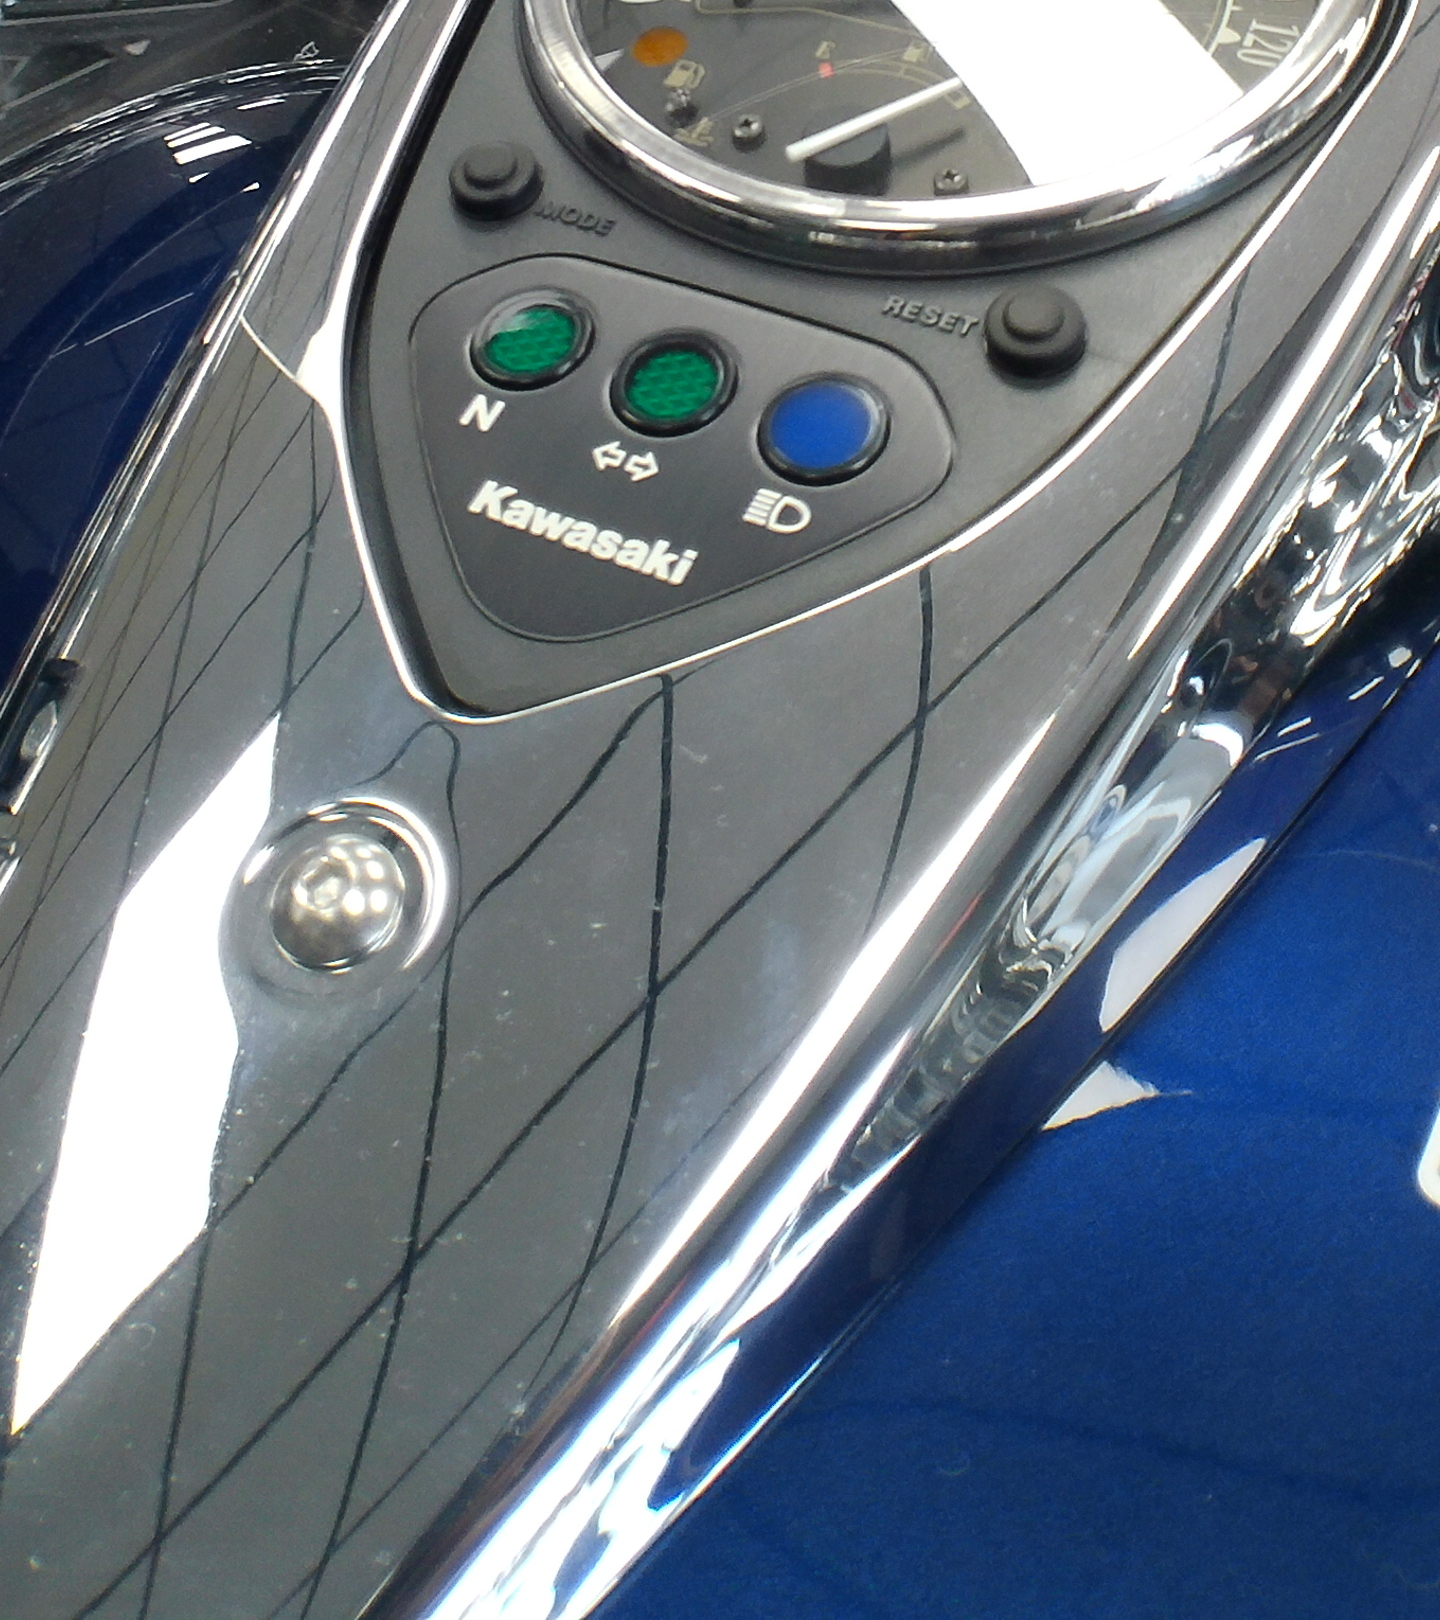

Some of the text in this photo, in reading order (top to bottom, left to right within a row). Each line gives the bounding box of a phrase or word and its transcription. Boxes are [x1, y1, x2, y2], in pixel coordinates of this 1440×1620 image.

[1236, 18, 1299, 67] 120
[534, 202, 617, 236] MODE
[880, 293, 980, 338] RESET
[460, 394, 505, 432] N
[467, 479, 698, 585] Kawasaki
